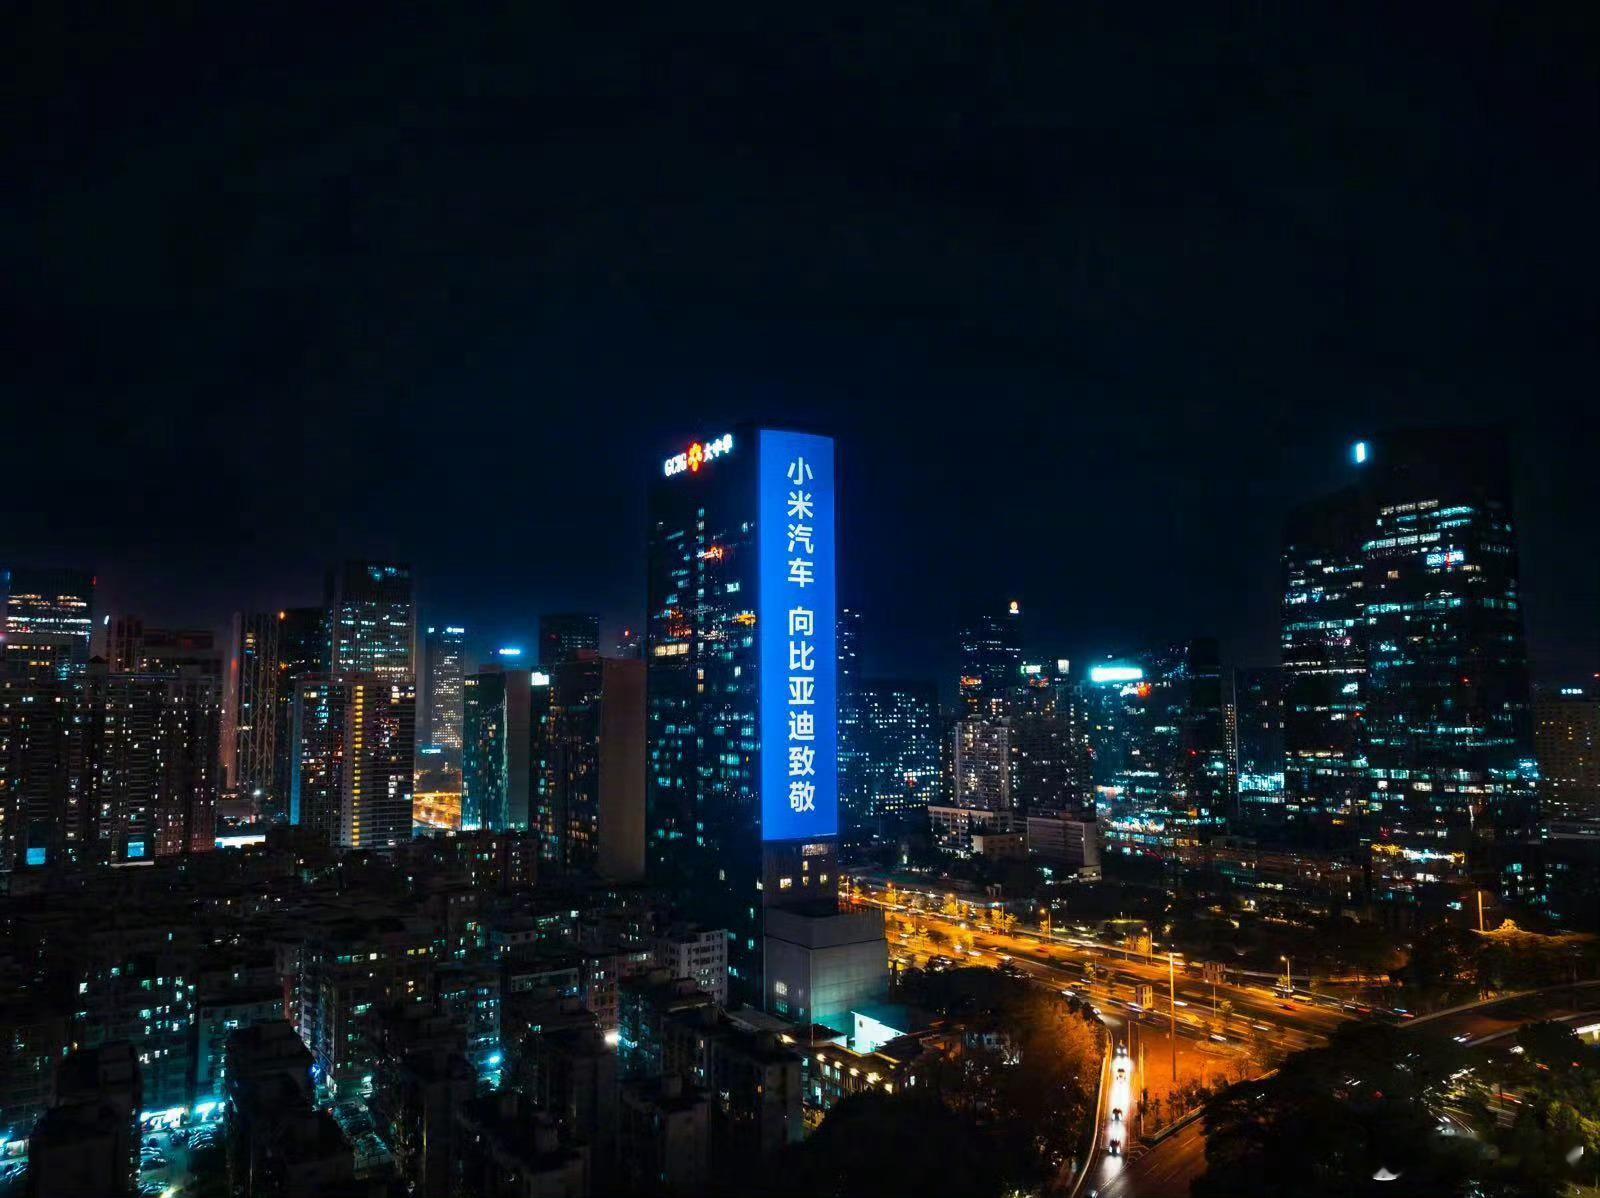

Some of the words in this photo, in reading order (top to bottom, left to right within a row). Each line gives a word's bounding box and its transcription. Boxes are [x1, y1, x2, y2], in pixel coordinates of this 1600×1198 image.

[786, 456, 815, 589] 小米汽车
[787, 605, 816, 814] 向比亚迪致敬
